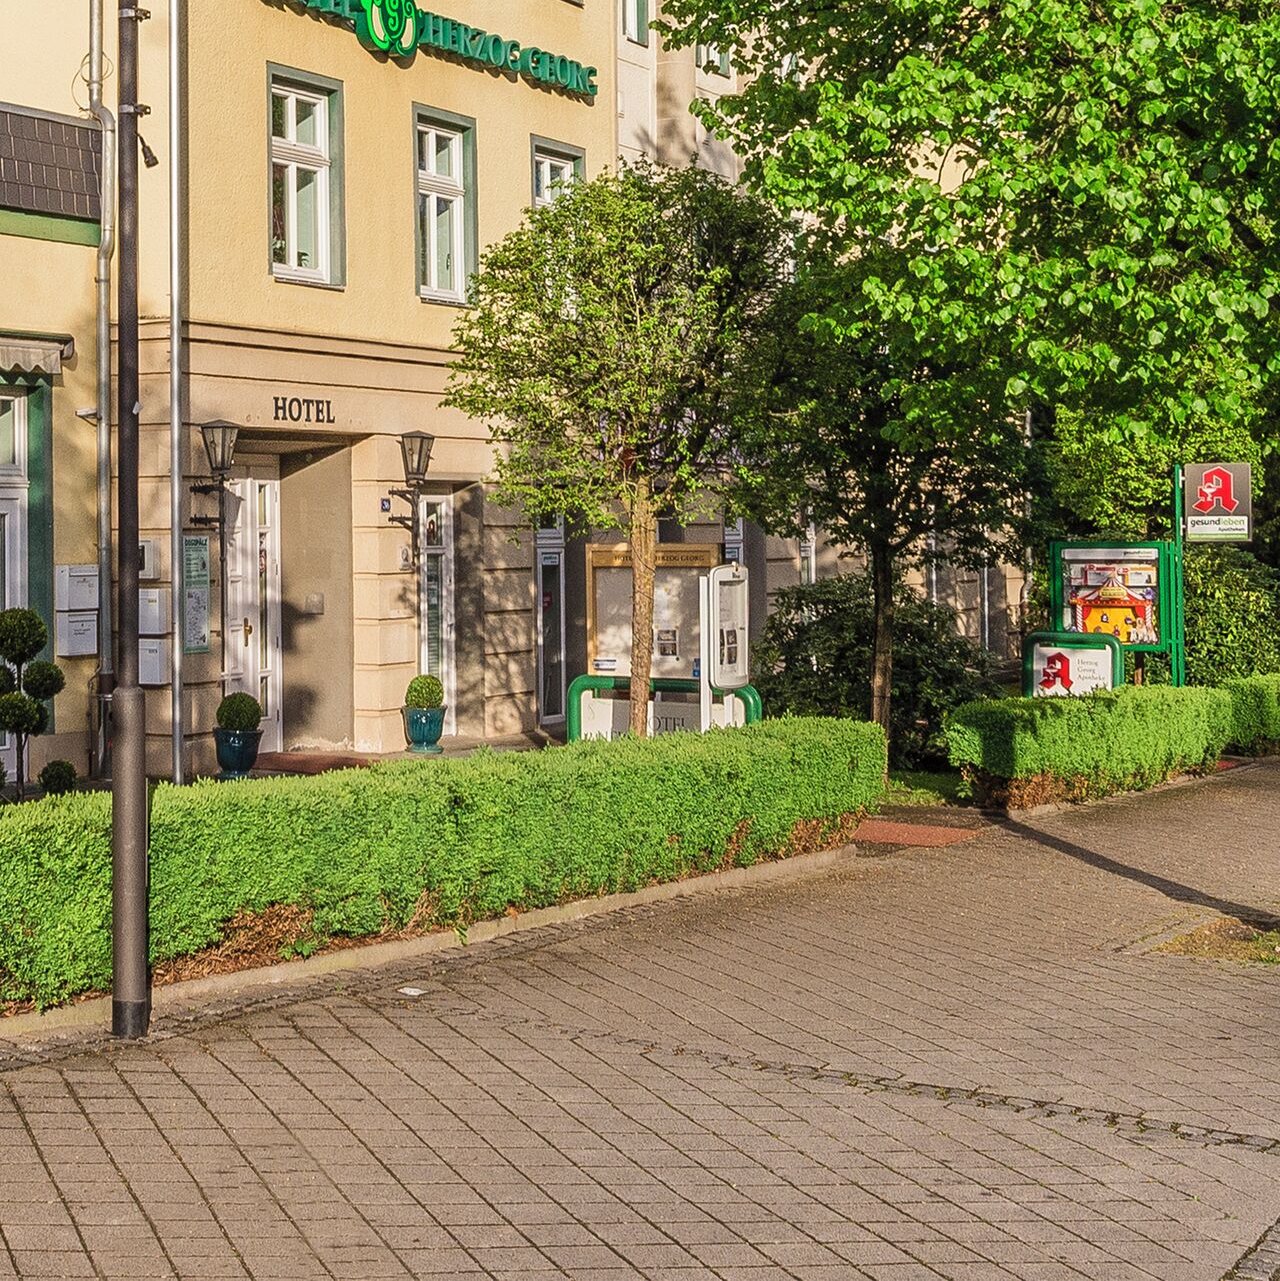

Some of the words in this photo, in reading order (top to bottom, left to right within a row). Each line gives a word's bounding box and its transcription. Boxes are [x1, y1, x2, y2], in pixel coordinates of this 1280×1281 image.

[418, 11, 520, 71] HERZOG
[520, 47, 597, 96] GEORG
[273, 396, 335, 423] HOTEL
[1190, 518, 1245, 527] gesundleben
